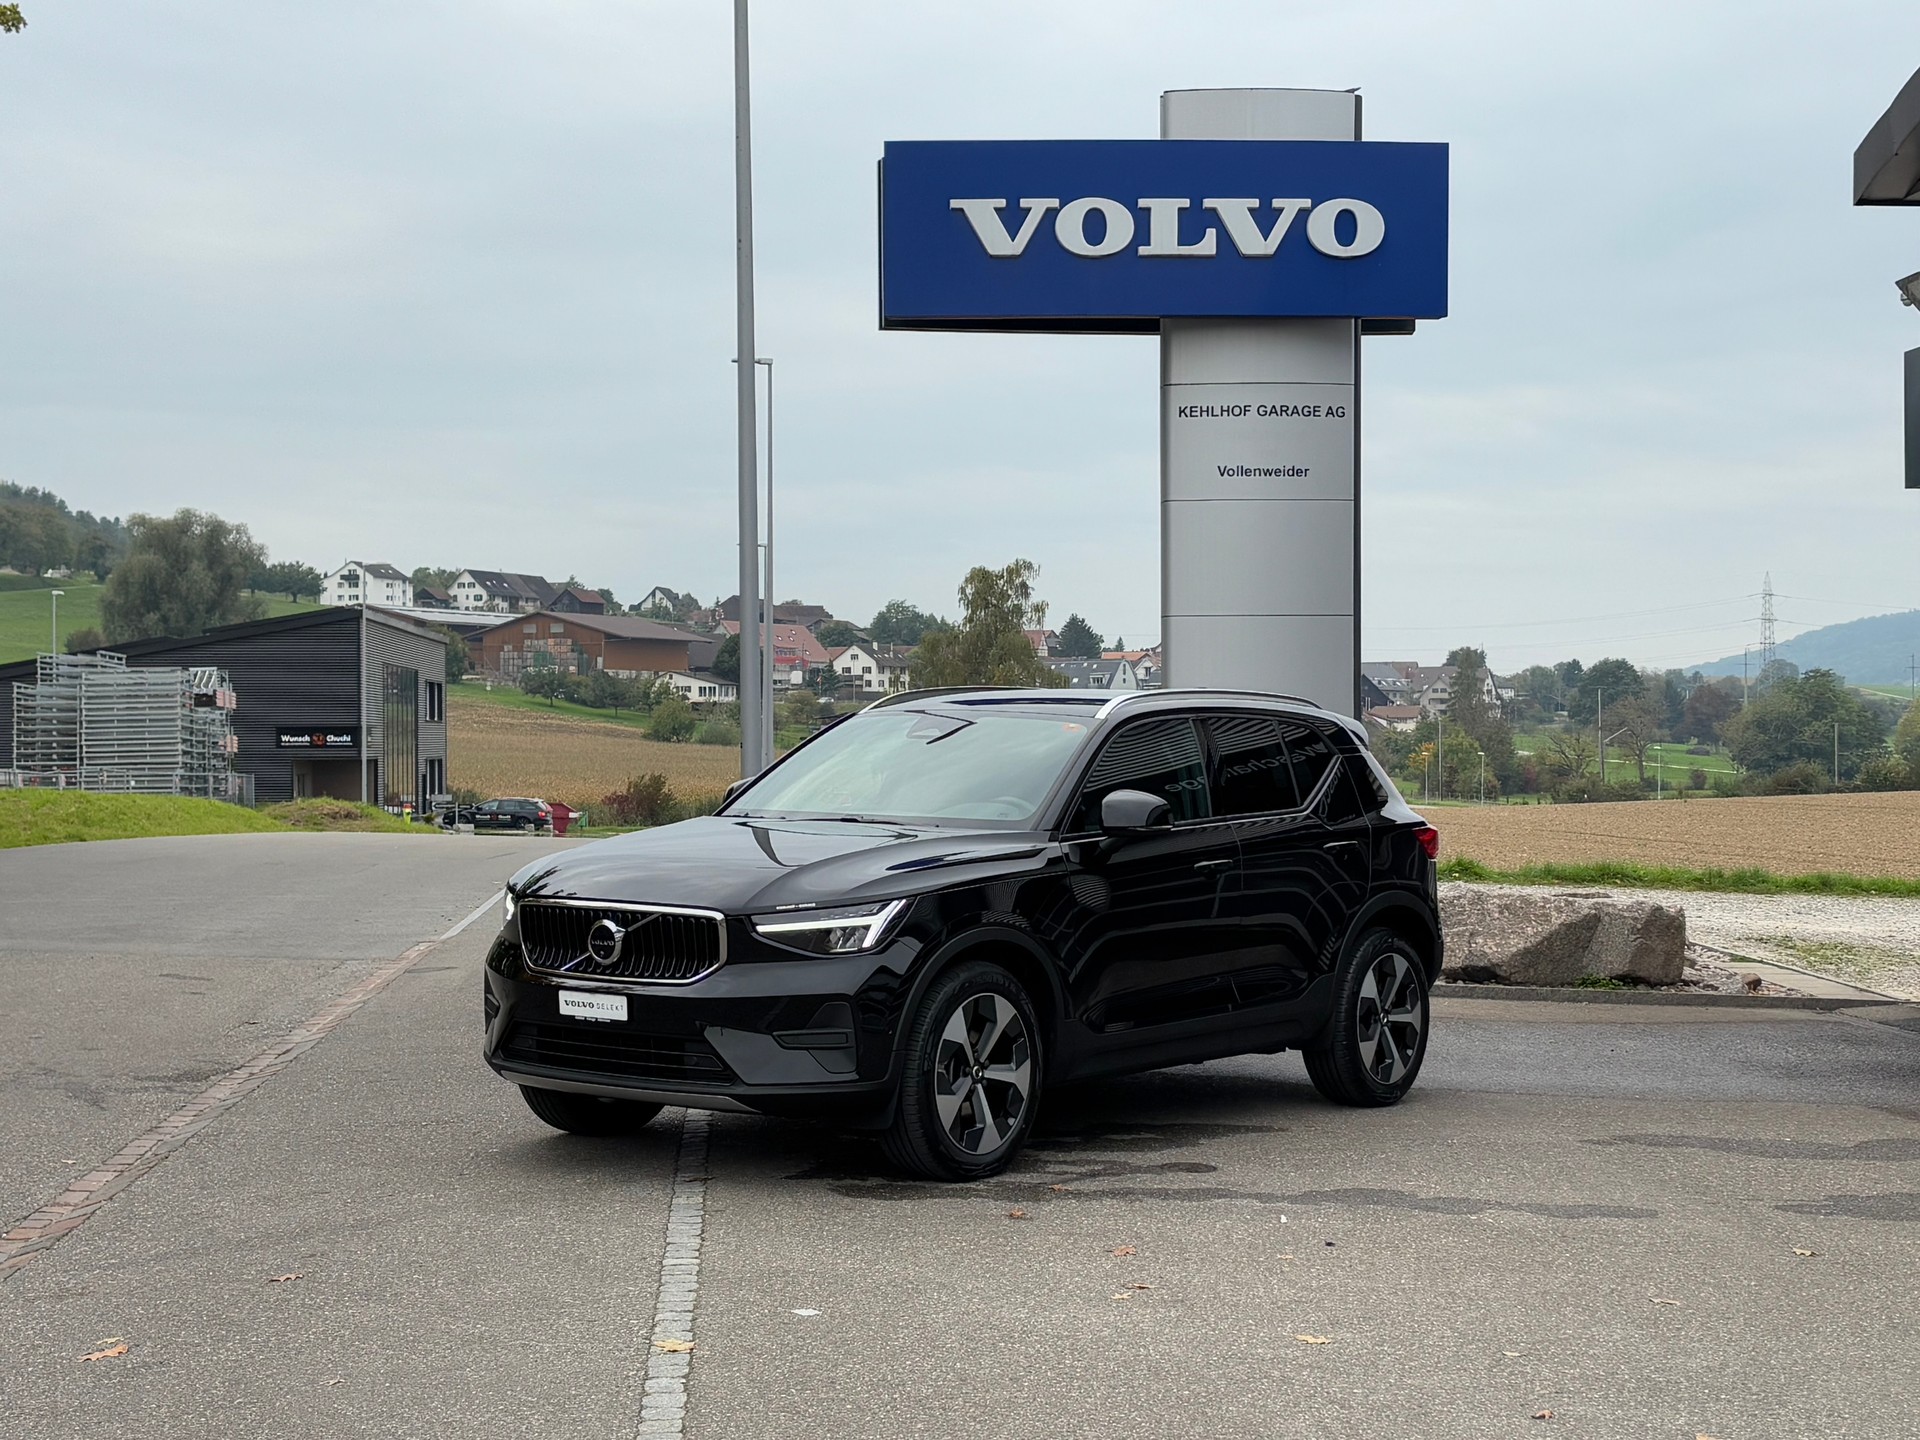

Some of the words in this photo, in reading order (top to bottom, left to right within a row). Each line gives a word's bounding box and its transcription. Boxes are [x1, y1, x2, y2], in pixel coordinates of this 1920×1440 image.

[950, 197, 1386, 258] VOLVO
[1178, 405, 1252, 418] KEHLHOF
[1256, 405, 1322, 417] GARAGE
[1325, 406, 1346, 418] AG
[1217, 465, 1310, 477] Vollenweider
[280, 734, 311, 742] Wunsch
[564, 999, 595, 1009] VOLVO
